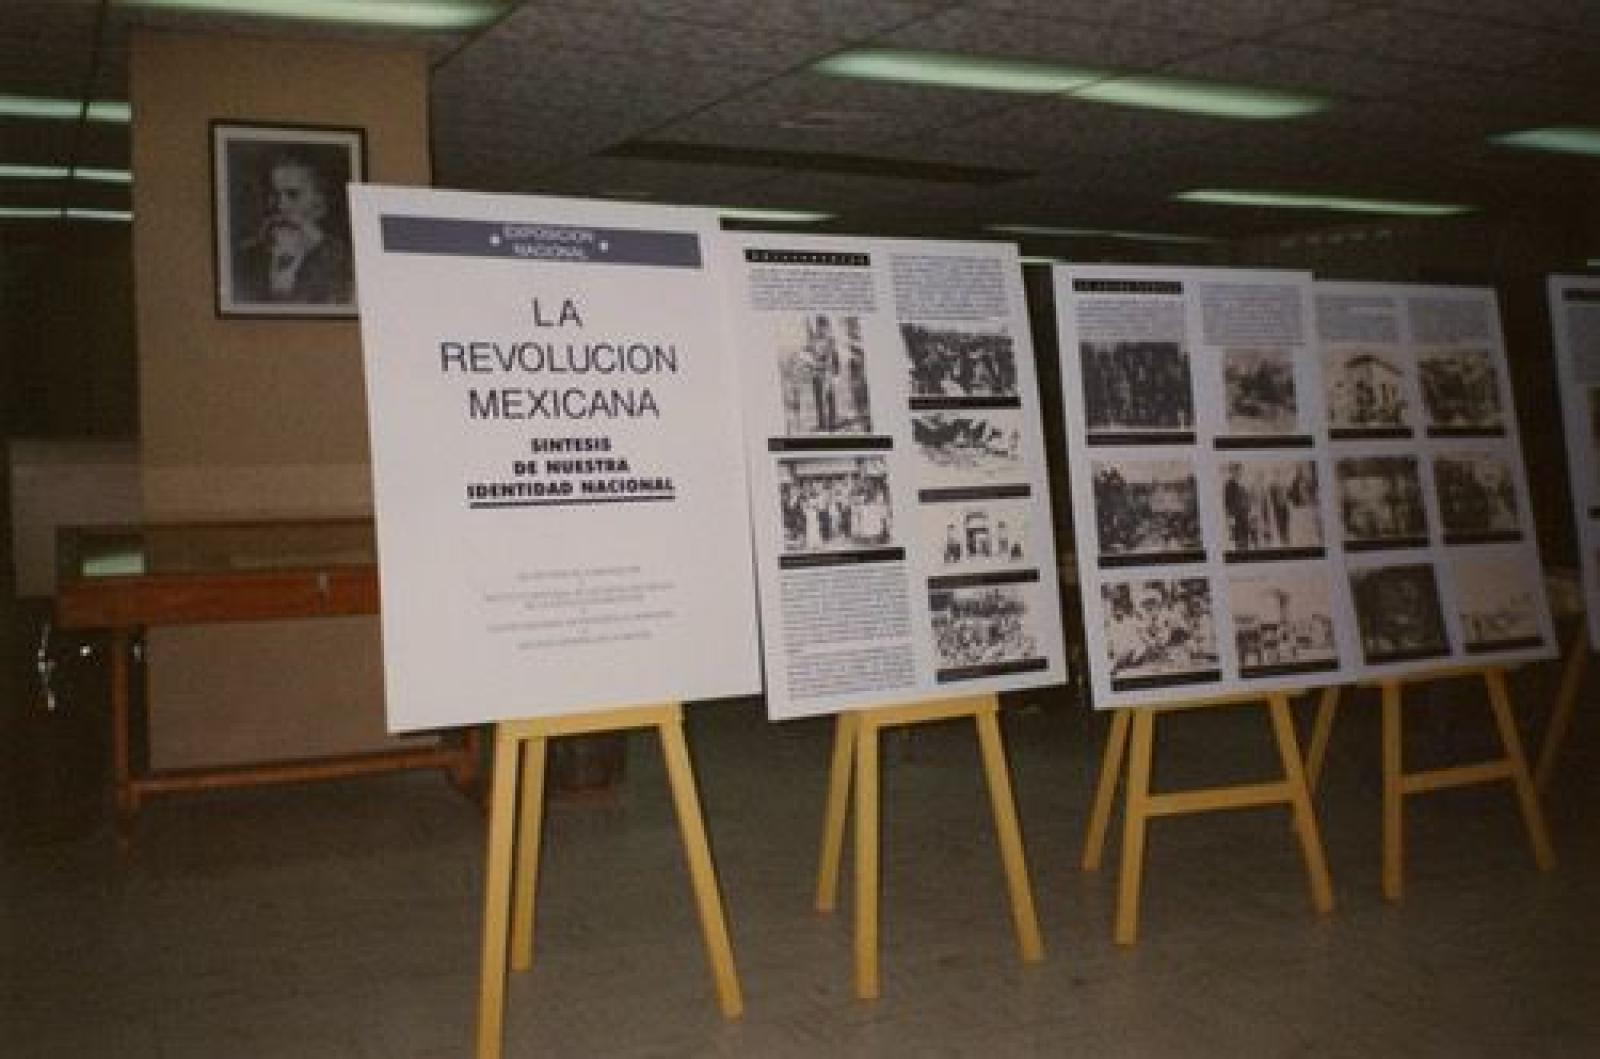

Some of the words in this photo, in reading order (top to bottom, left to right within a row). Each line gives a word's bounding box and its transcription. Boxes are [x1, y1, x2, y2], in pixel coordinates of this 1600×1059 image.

[533, 297, 583, 327] LA
[440, 341, 678, 373] REVOLUCION
[468, 387, 660, 420] MEXICANA
[530, 437, 612, 453] SINTESIS
[513, 460, 538, 476] DE
[546, 459, 630, 475] NUESTRA
[466, 482, 574, 499] IDENTIDAD
[581, 478, 675, 494] NACIONAL
